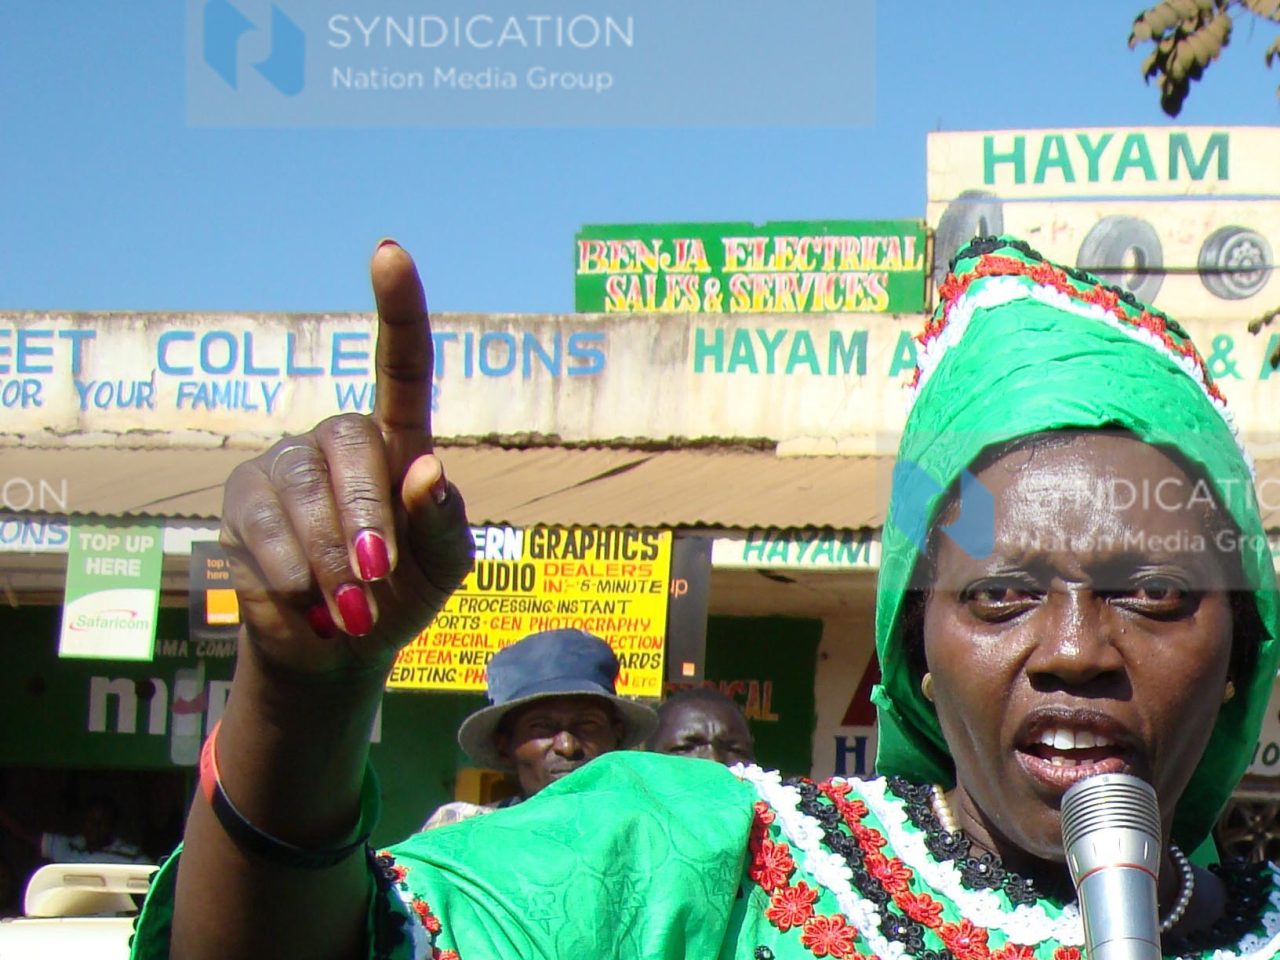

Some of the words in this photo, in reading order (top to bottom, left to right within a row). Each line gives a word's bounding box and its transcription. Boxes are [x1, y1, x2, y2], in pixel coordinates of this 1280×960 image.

[983, 132, 1229, 185] HAYAM
[577, 238, 711, 275] BENJA
[721, 235, 924, 272] ELECTRICAL
[605, 274, 700, 313] SALES
[704, 277, 723, 313] &
[729, 272, 890, 313] SERVICES
[156, 329, 608, 380] COLLETIONS
[693, 328, 868, 377] HAYAM
[1207, 333, 1243, 380] &
[0, 379, 43, 410] OR
[74, 379, 155, 412] YOUR
[176, 380, 283, 415] FAMILY
[79, 532, 120, 551] TOP
[125, 534, 154, 552] UP
[472, 526, 523, 561] ERN
[530, 527, 659, 561] GRAPHICS
[742, 530, 873, 564] HAYAM
[85, 557, 142, 577] HERE
[206, 558, 223, 571] top
[543, 563, 653, 578] DEALERS
[206, 570, 230, 581] here
[459, 561, 536, 593] UDIO
[557, 599, 632, 614] INSTANT
[75, 614, 149, 630] Safaricom
[529, 616, 651, 632] PHOTOGRAPHY
[432, 633, 495, 649] SPECIAL
[389, 667, 457, 683] EDITING
